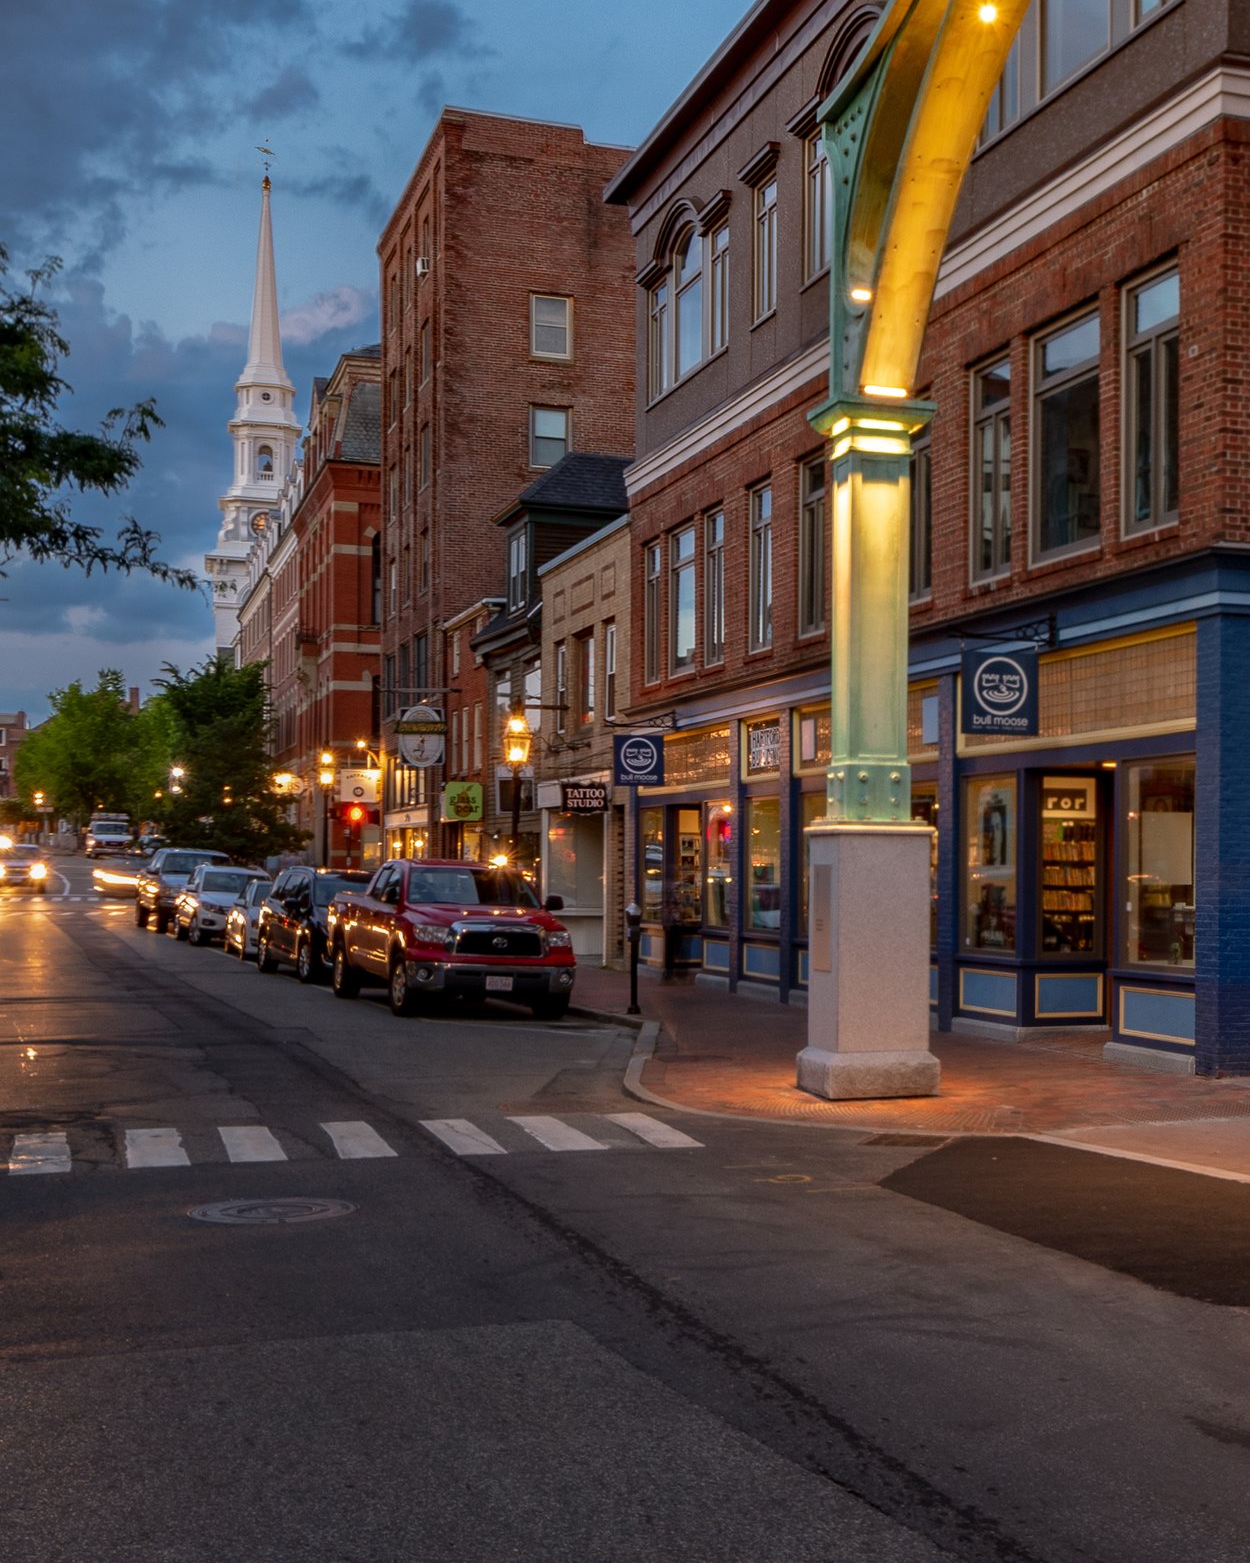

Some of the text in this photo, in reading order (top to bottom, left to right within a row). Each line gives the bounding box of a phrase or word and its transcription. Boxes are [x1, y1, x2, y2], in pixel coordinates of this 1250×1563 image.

[973, 713, 1029, 727] bull moose
[620, 773, 634, 781] bull
[565, 788, 605, 798] TATTOO
[567, 798, 604, 808] STUDIO
